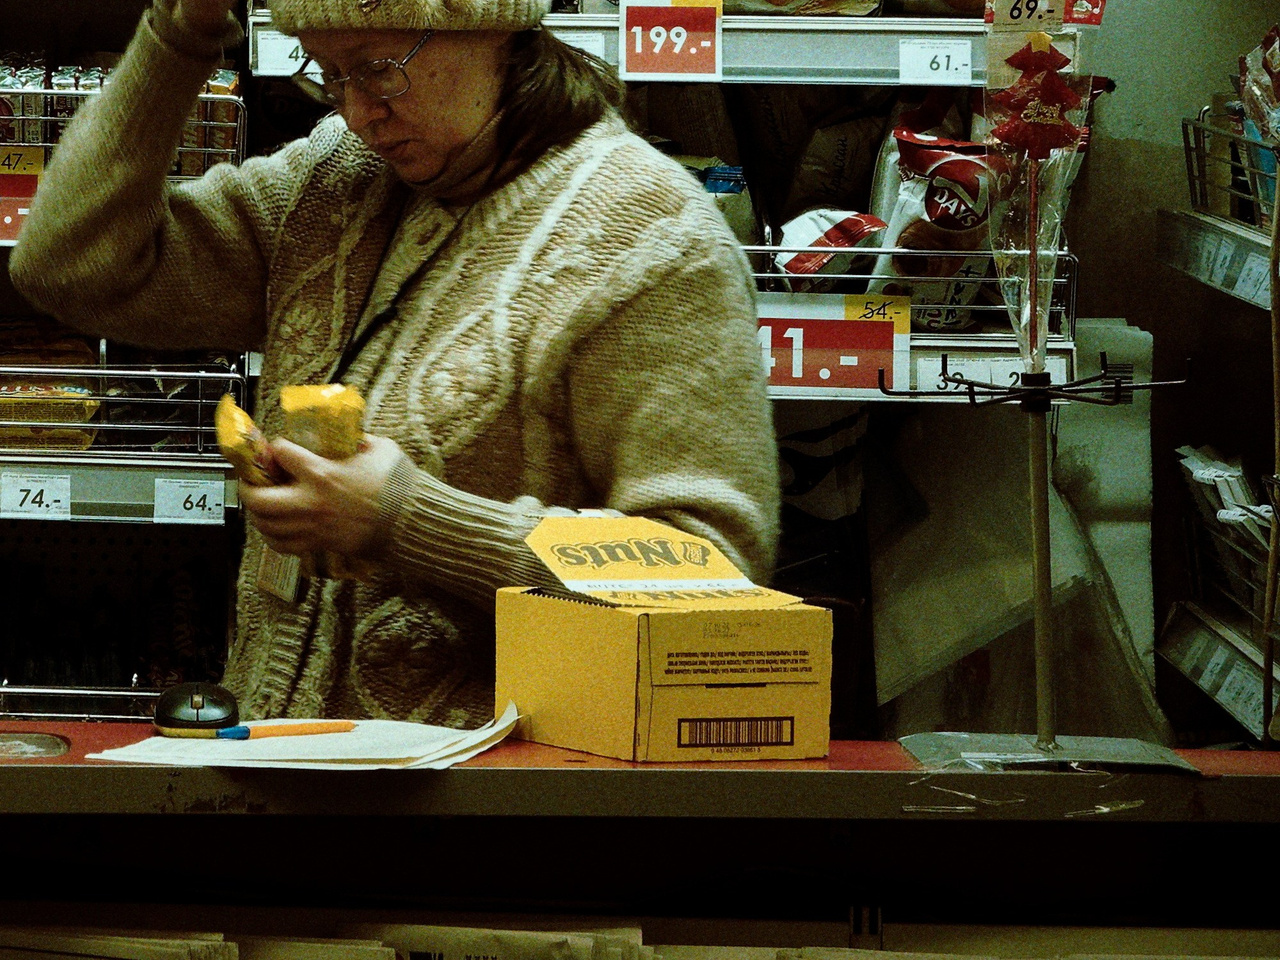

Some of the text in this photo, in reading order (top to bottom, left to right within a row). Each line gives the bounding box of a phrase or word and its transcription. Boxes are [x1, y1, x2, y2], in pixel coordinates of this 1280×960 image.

[631, 25, 712, 56] 199.-
[929, 53, 970, 73] 61.-
[1, 152, 35, 172] 47.-
[934, 189, 977, 227] DAYS
[18, 489, 62, 510] 74.-
[182, 493, 222, 513] 64.-
[558, 538, 682, 569] Nuts
